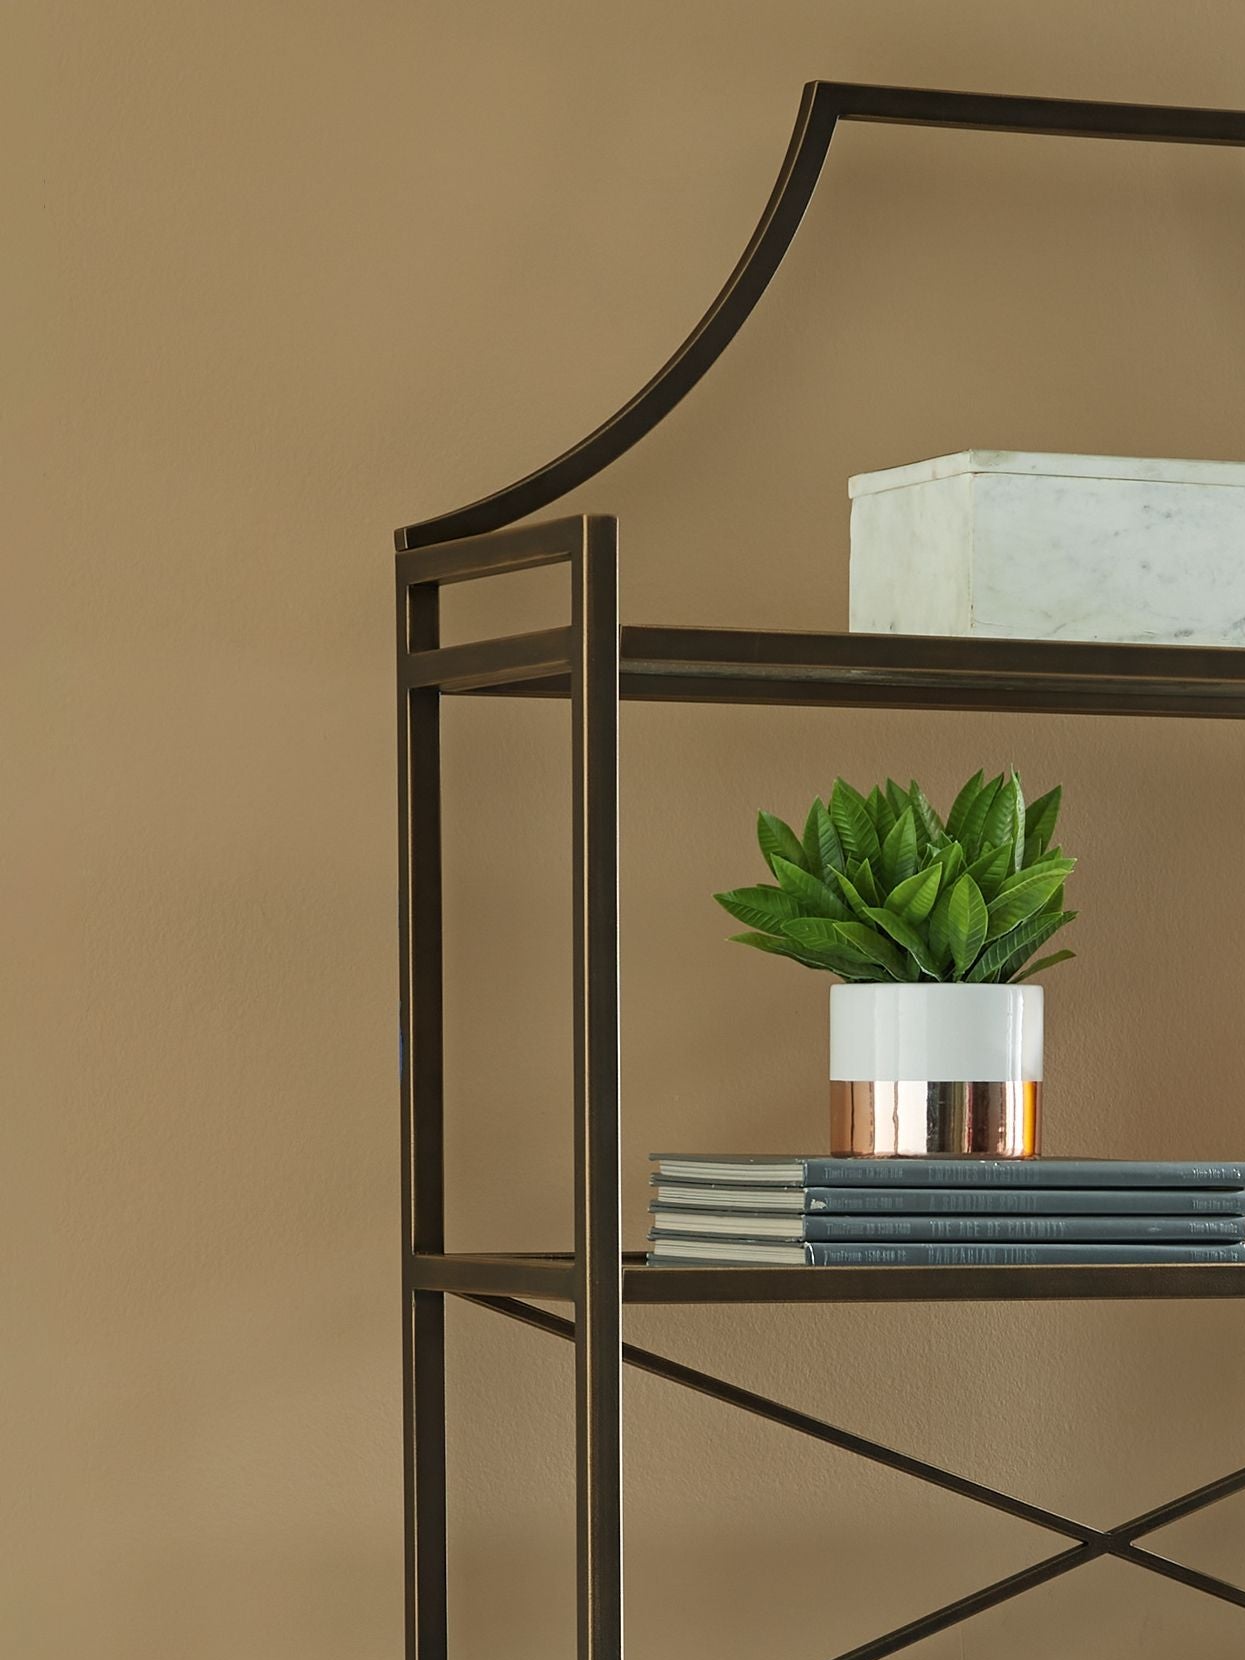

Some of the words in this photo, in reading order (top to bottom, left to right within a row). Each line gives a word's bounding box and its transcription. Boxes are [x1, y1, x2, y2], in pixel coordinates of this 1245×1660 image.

[930, 1220, 952, 1237] THE
[959, 1220, 981, 1237] AGE
[987, 1220, 1002, 1237] OF
[1008, 1220, 1066, 1237] CALAMITY
[1004, 1248, 1039, 1264] TIDES
